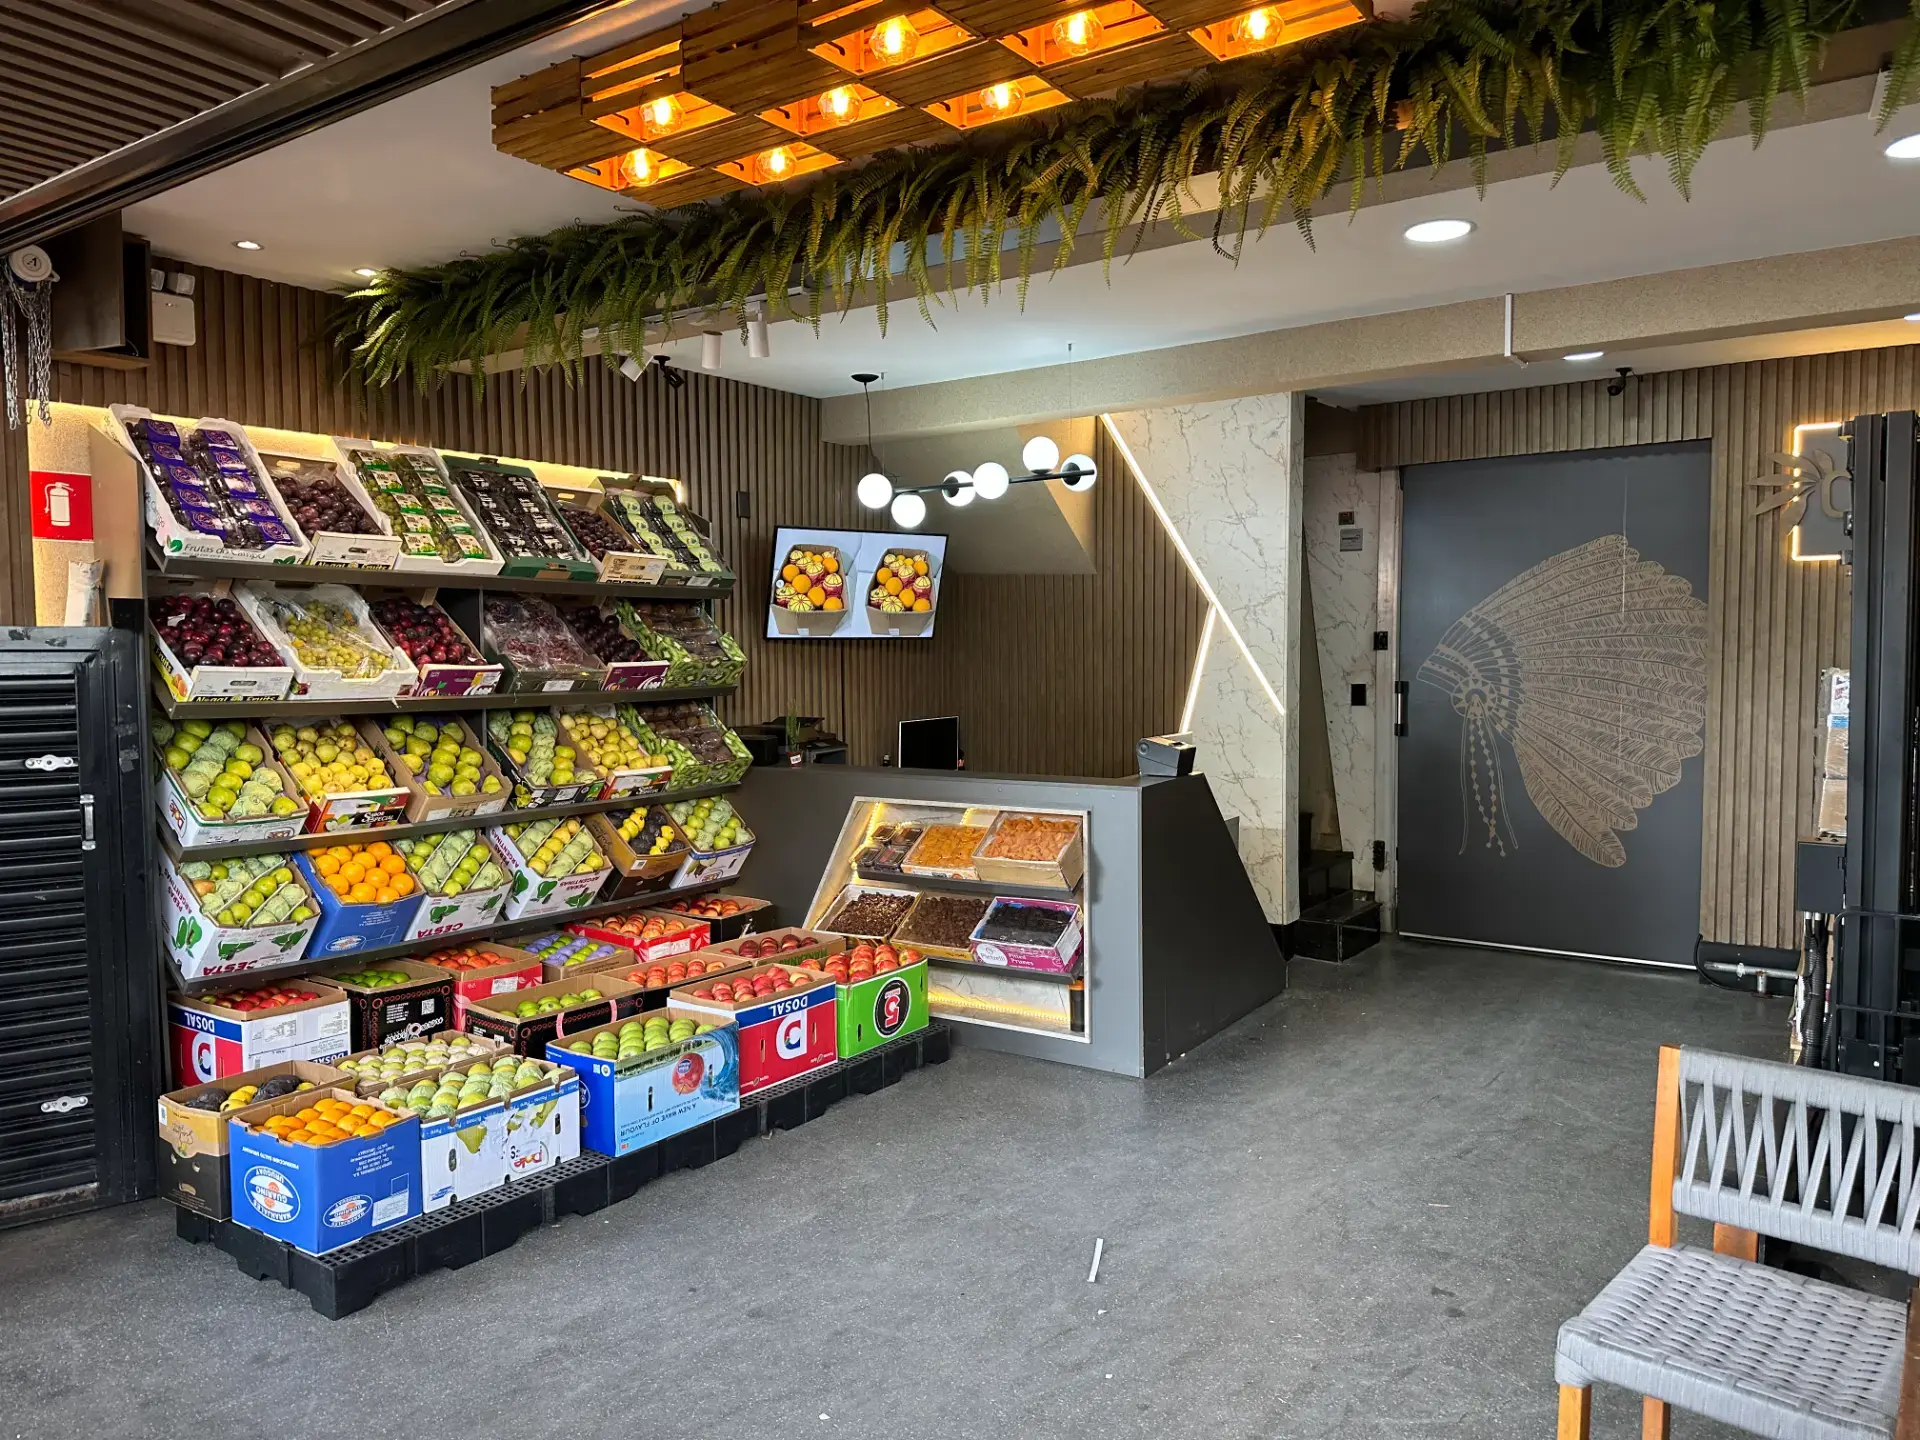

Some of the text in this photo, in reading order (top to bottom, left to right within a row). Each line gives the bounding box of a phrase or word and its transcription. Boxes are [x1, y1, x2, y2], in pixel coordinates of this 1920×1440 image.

[184, 543, 214, 554] Frutas
[169, 799, 185, 830] Dole
[490, 828, 520, 868] ARGENTINAS
[167, 886, 184, 912] PERAS
[416, 922, 464, 939] CESTA
[769, 995, 808, 1017] DOSAL
[884, 994, 900, 1028] 5
[183, 1012, 216, 1034] DOSAL
[661, 1110, 677, 1122] WAVE
[677, 1106, 691, 1115] NEW
[620, 1122, 650, 1137] FLAVOUR
[650, 1117, 660, 1126] OF
[513, 1152, 542, 1169] Dole
[255, 1167, 285, 1184] URUGUAY
[255, 1186, 288, 1204] GUARINO
[253, 1199, 292, 1221] NARANJALES
